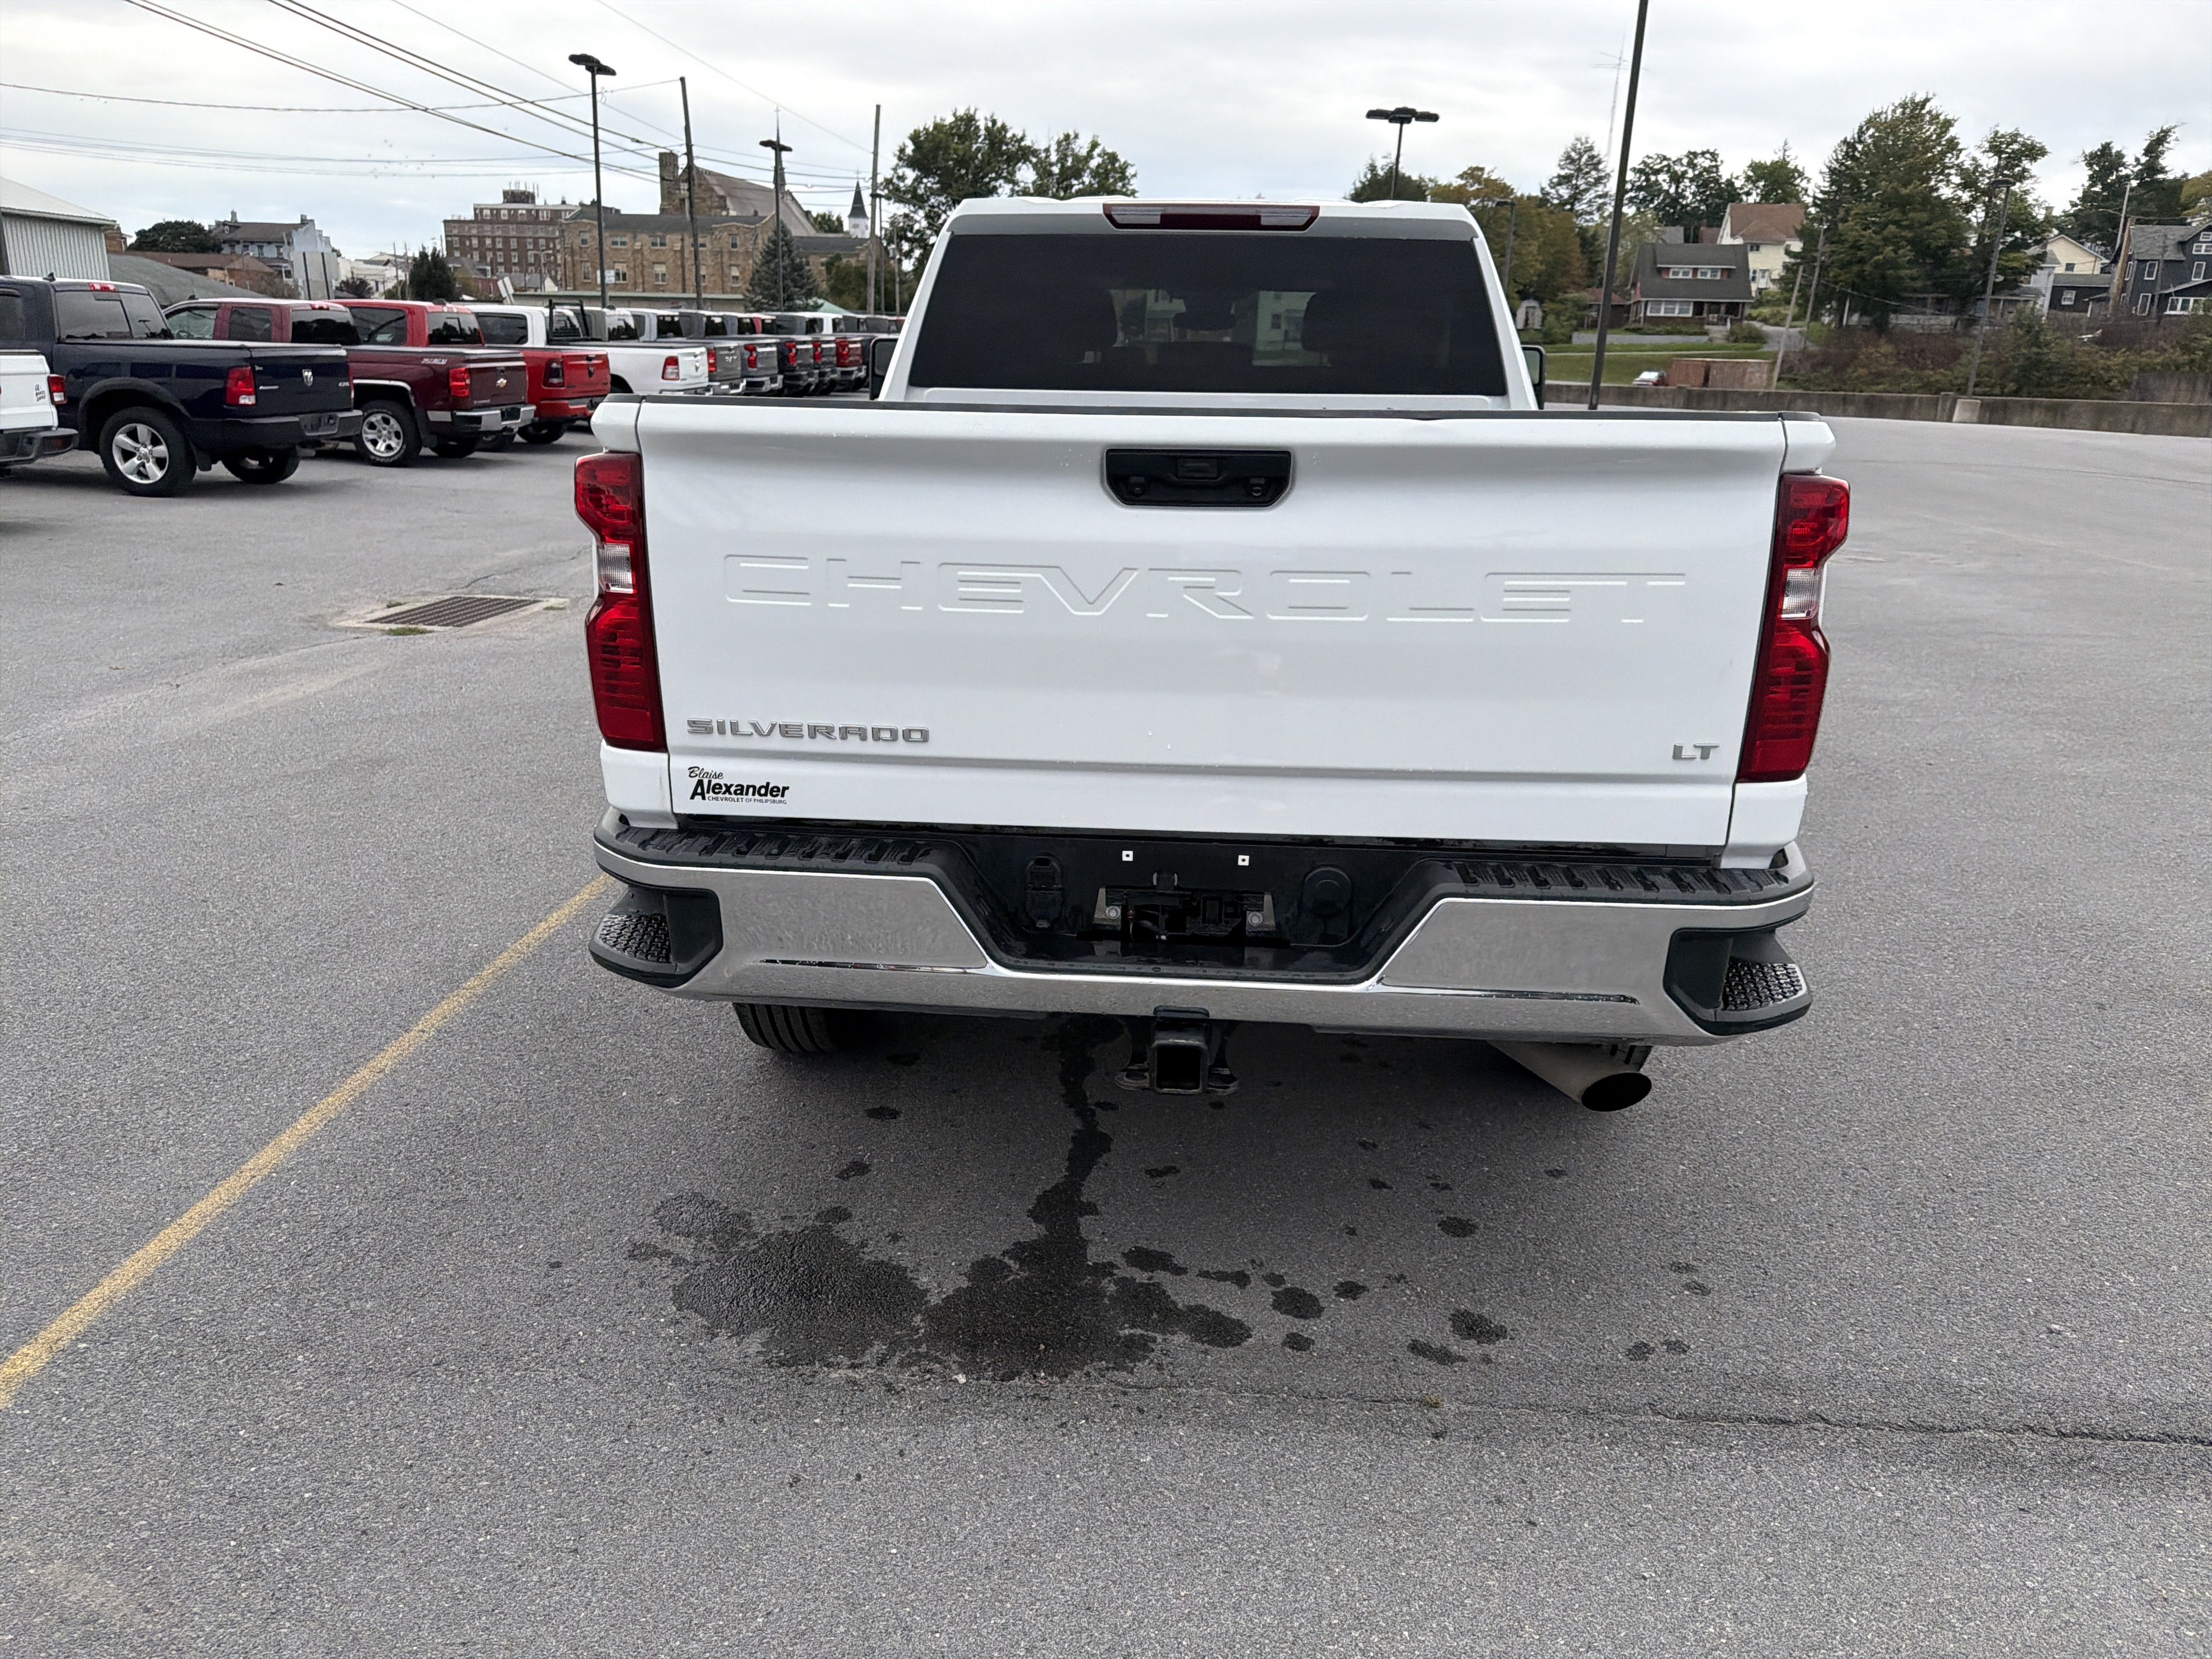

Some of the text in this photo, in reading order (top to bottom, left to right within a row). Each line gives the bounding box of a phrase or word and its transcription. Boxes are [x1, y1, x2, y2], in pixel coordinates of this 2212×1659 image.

[724, 554, 1686, 623] CHEVROLET
[686, 718, 930, 743] SILVERADO
[1672, 743, 1720, 759] LT
[687, 766, 724, 779] Blaise
[689, 778, 790, 800] Alexander
